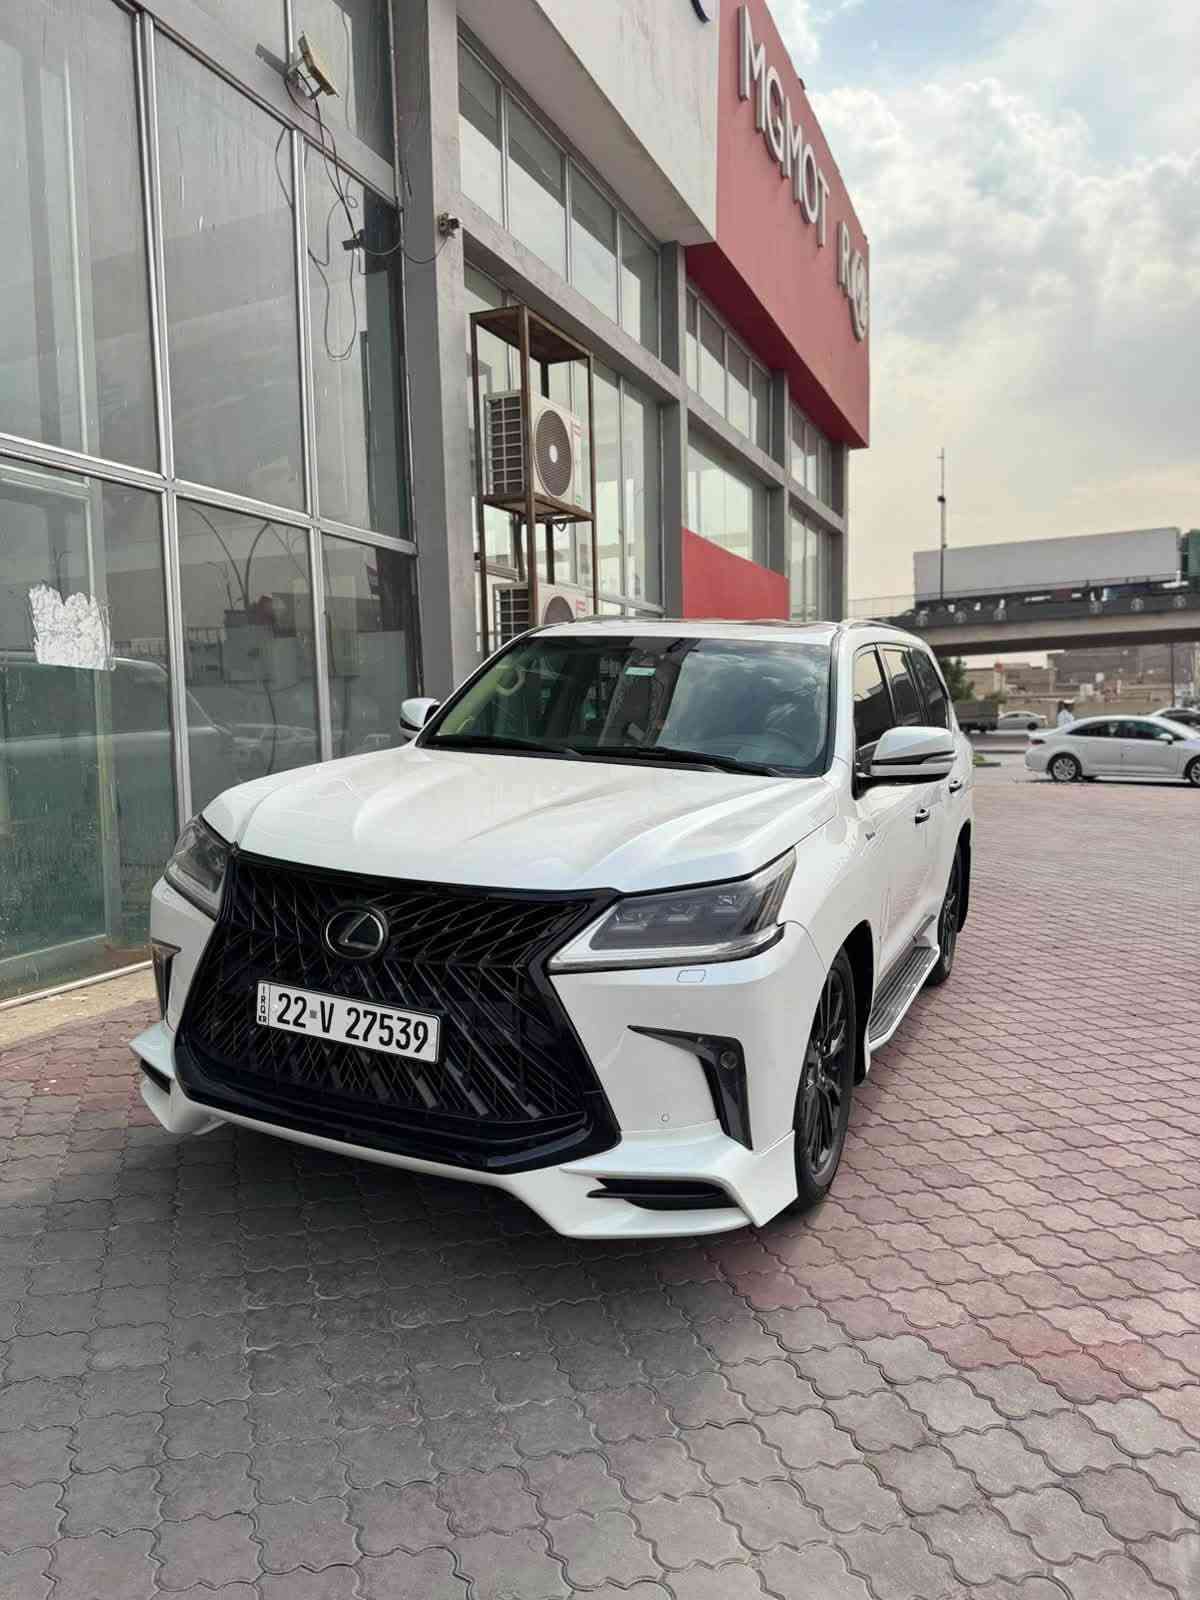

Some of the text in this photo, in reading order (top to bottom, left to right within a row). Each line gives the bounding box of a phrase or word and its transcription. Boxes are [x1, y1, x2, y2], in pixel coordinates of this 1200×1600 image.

[277, 993, 429, 1053] 22 V 27539
